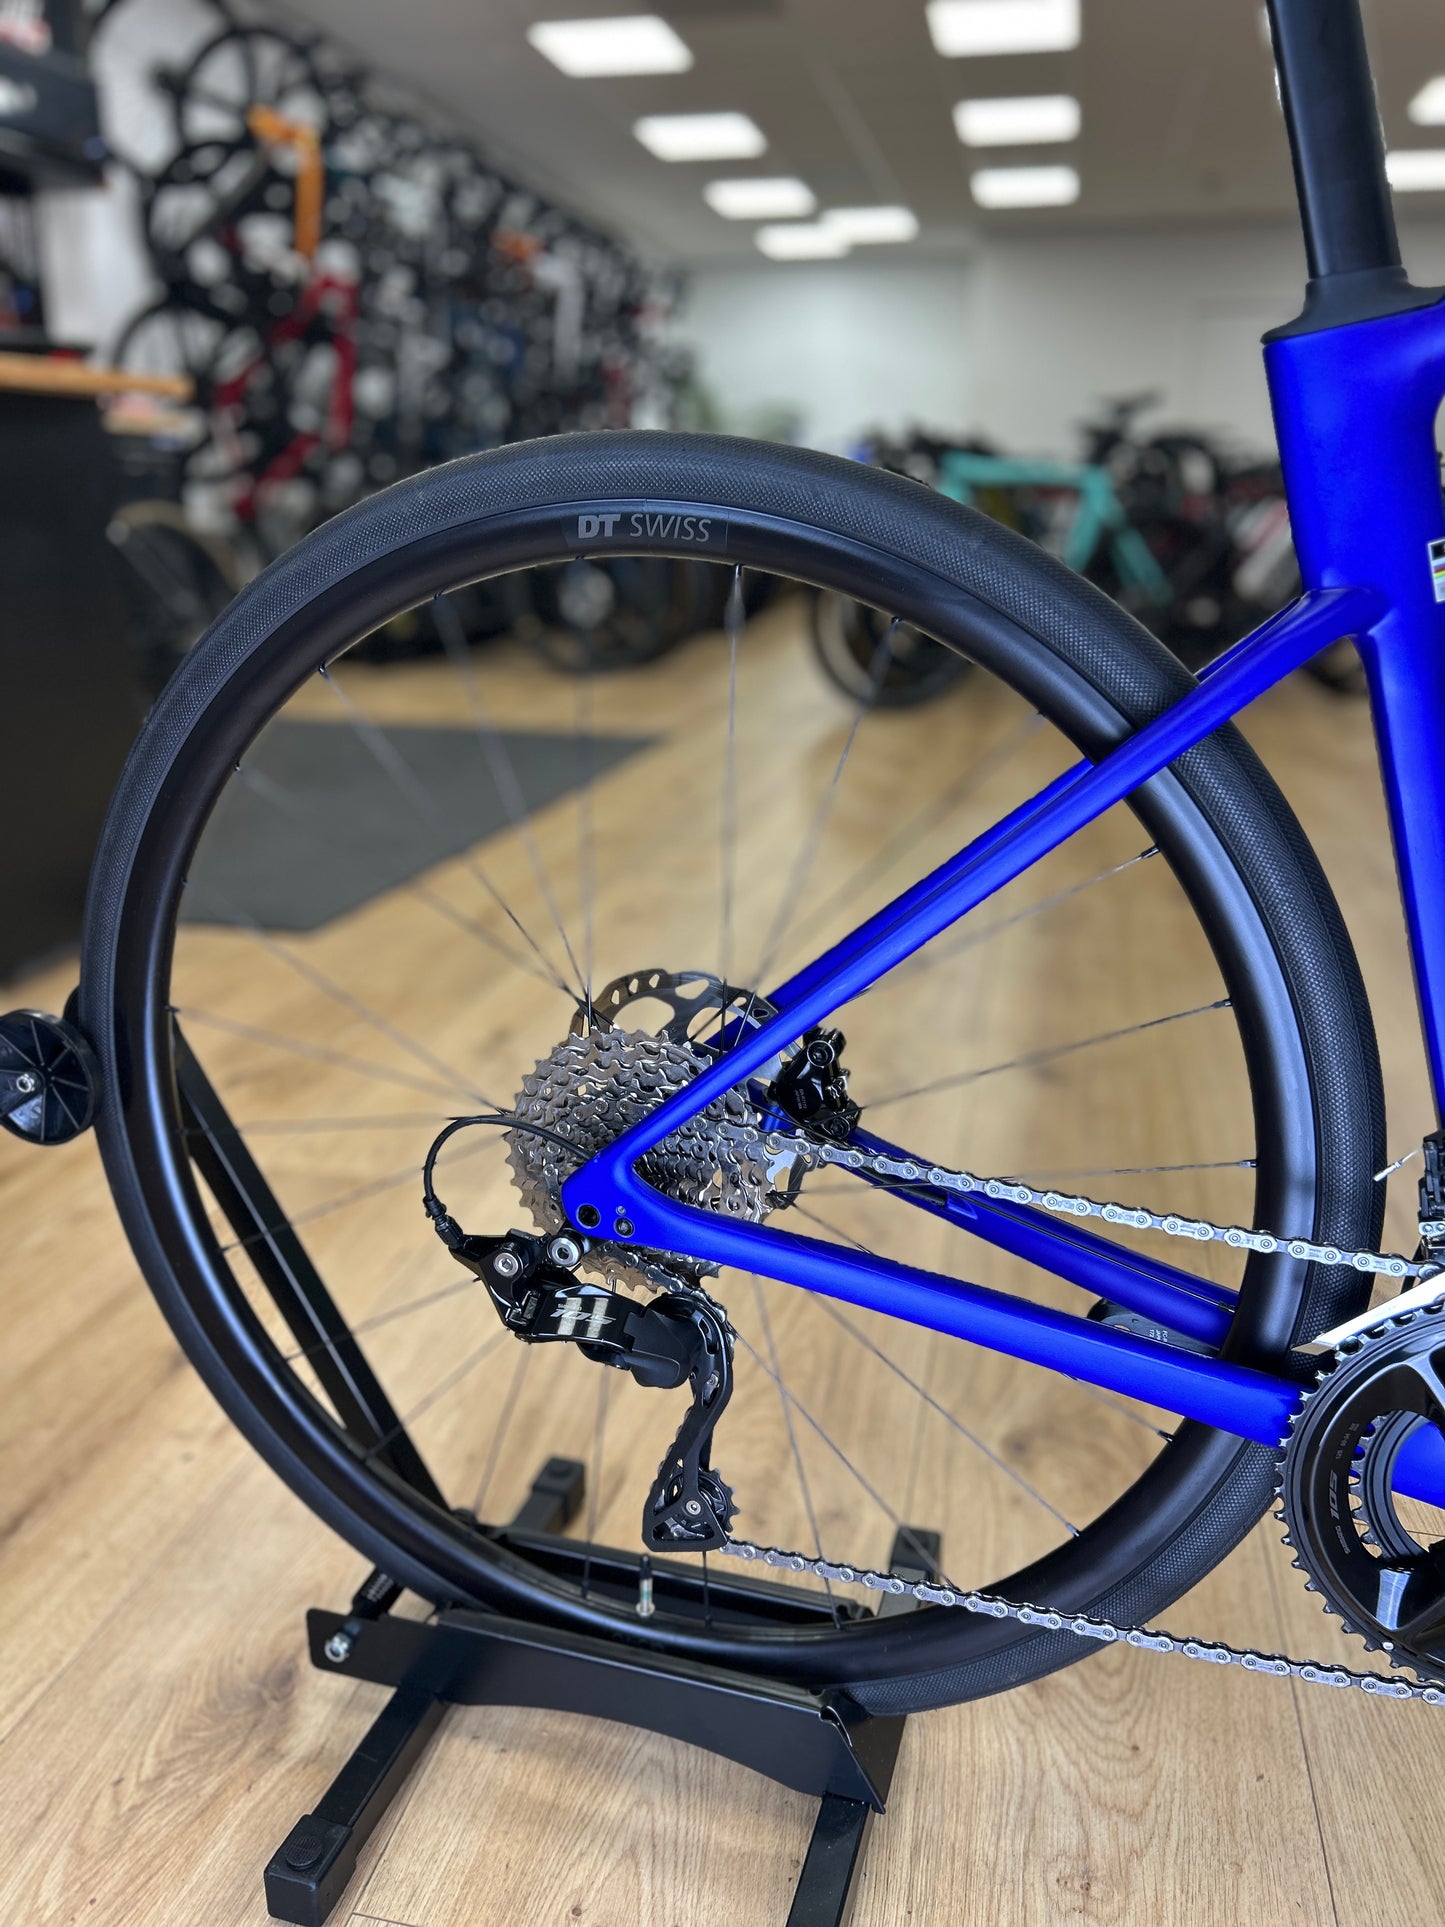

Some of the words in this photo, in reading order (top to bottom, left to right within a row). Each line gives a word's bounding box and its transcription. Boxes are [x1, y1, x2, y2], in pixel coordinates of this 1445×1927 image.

[578, 514, 621, 539] DT
[630, 513, 712, 543] SWISS
[1329, 1469, 1340, 1520] 105
